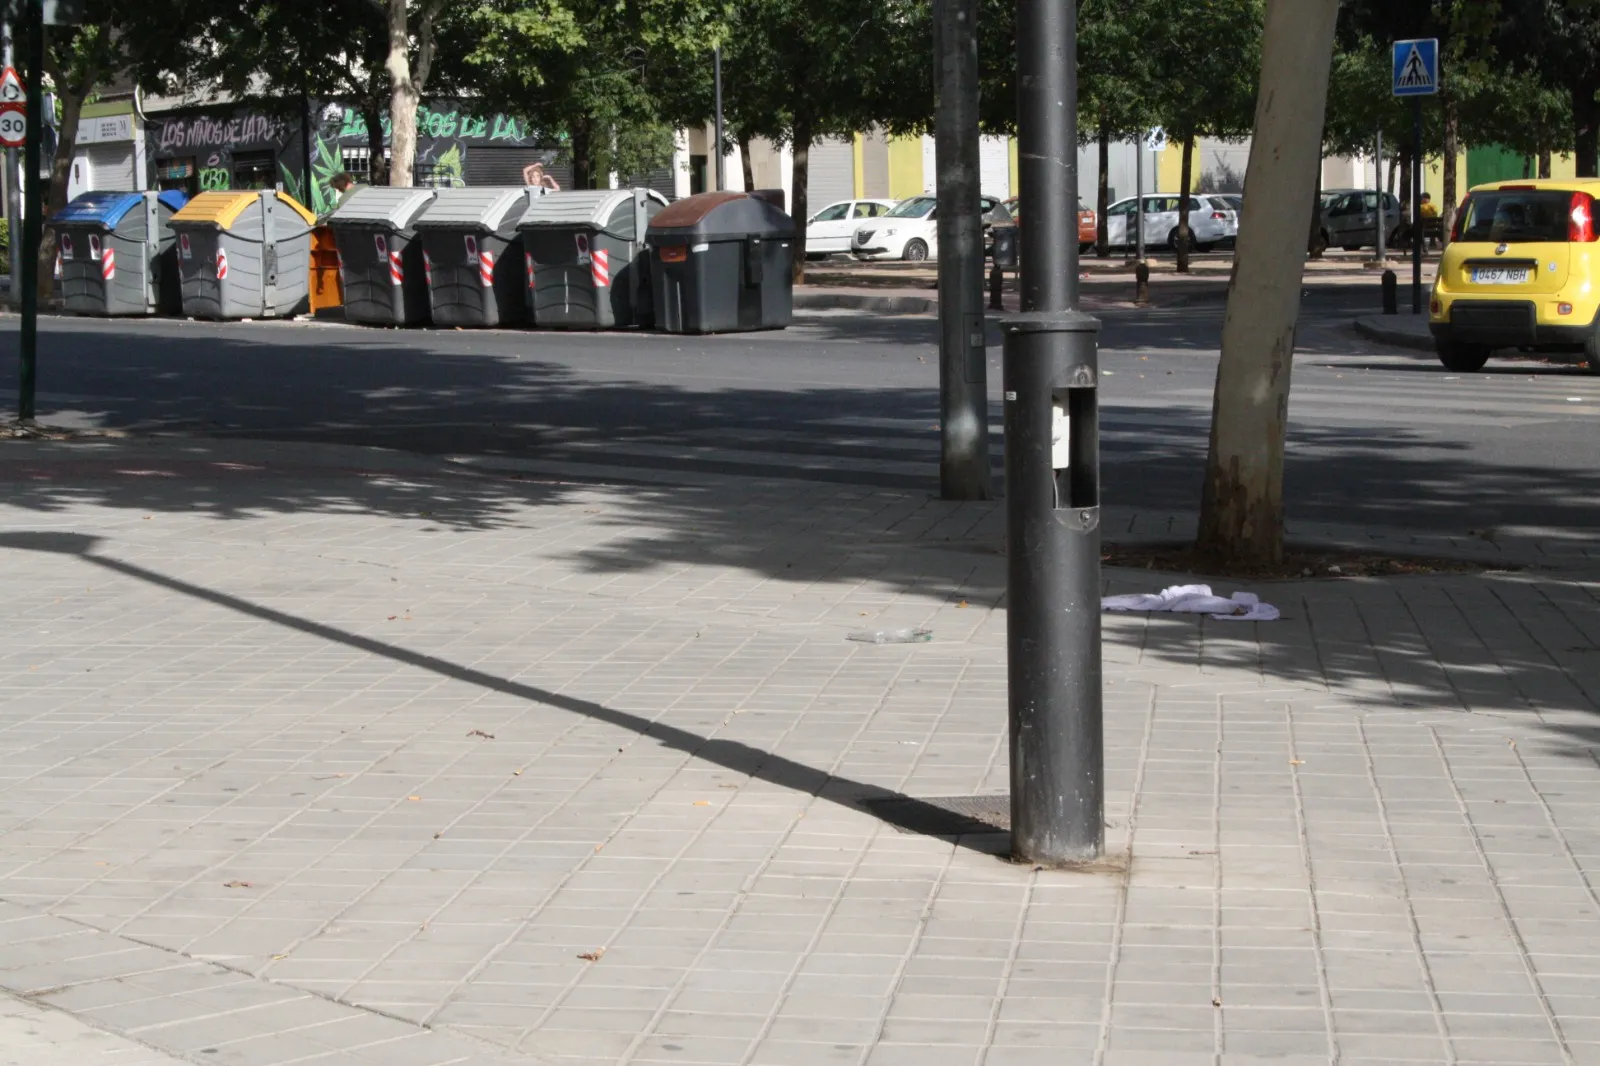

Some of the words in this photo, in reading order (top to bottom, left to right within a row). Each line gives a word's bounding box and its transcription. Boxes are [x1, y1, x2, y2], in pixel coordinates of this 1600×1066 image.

[1, 119, 24, 133] 30
[160, 120, 185, 149] LOS
[186, 116, 223, 147] NIÑOS
[224, 119, 241, 142] DE
[490, 111, 520, 142] LA
[199, 168, 228, 190] CBD
[1506, 268, 1527, 280] NBH
